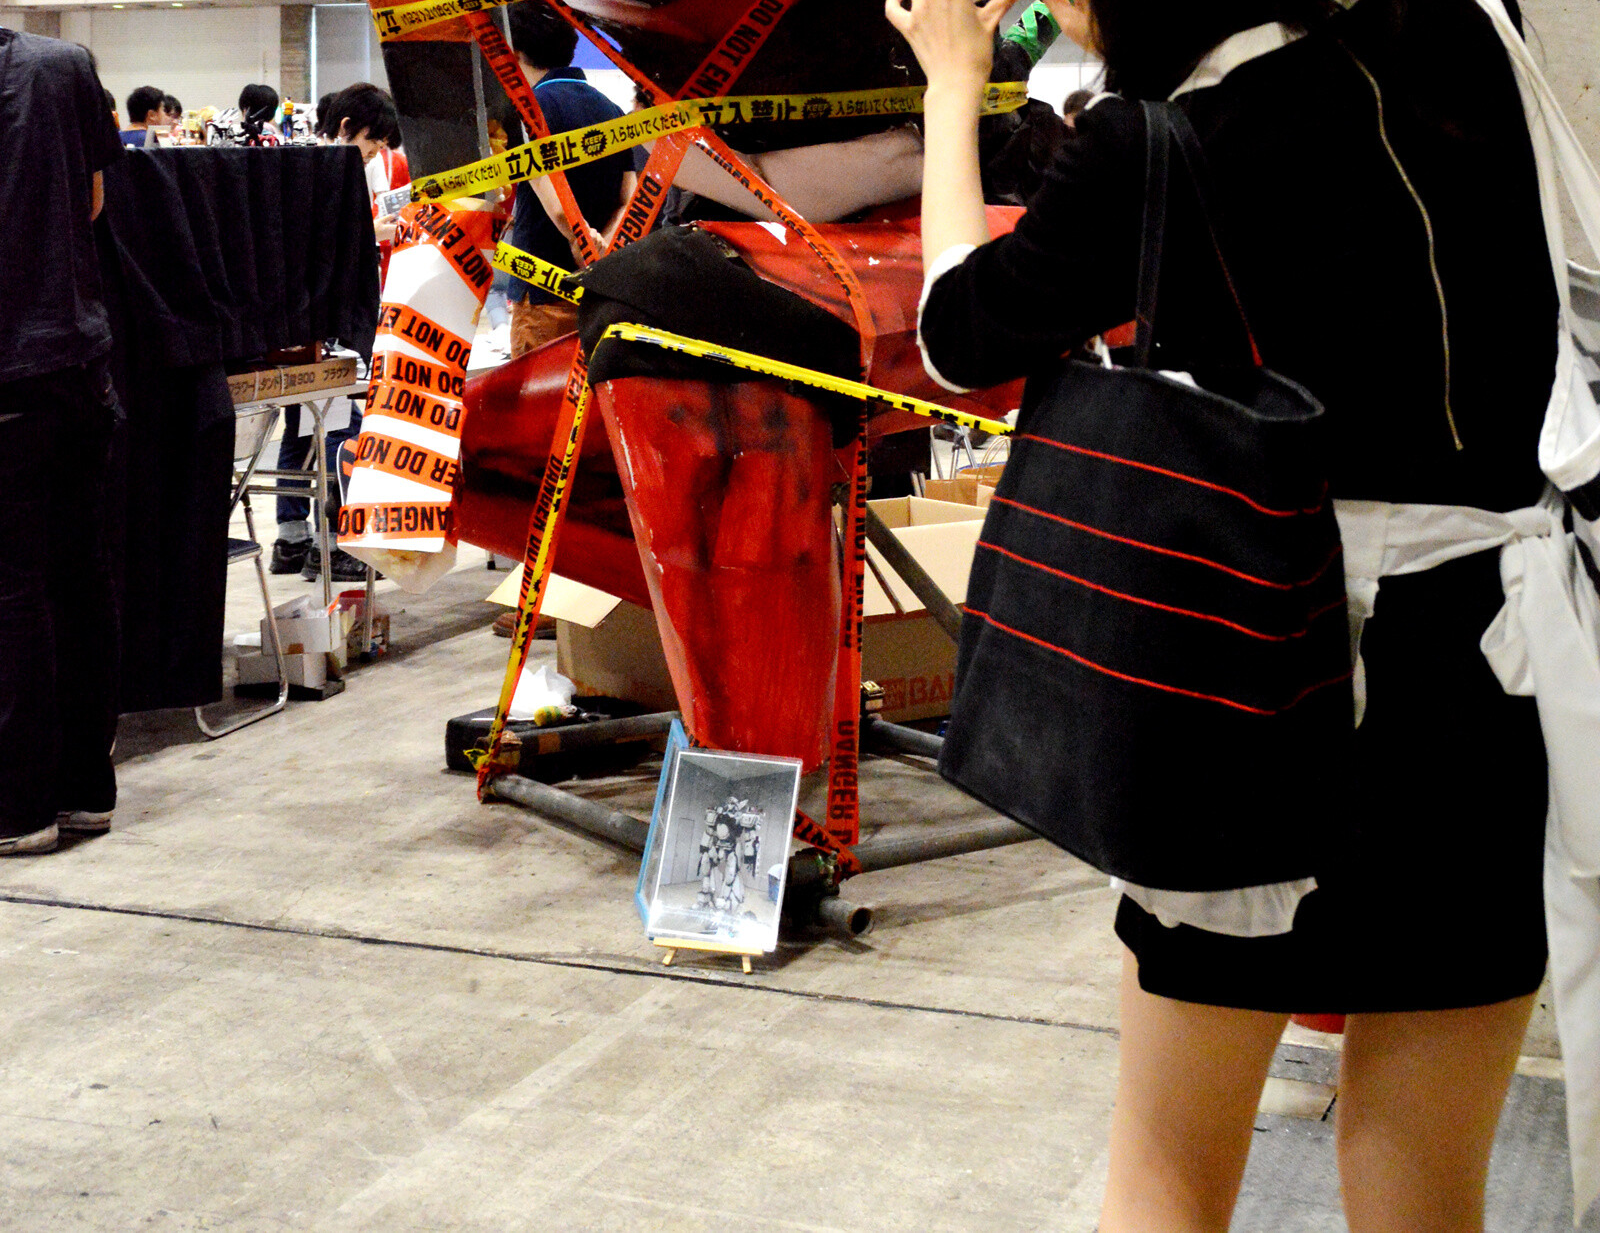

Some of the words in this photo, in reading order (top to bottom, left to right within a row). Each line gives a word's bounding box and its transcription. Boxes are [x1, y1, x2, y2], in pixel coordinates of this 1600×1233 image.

[719, 24, 762, 67] NOT
[681, 62, 731, 100] ENT
[611, 112, 691, 144] 入らないでください
[505, 140, 580, 181] 立入禁止
[588, 144, 601, 155] OUT
[442, 164, 502, 191] 入らないでください
[415, 204, 465, 250] ENTER
[614, 175, 662, 251] DANGE
[454, 245, 492, 289] NOT
[401, 315, 445, 353] NOT
[445, 340, 471, 371] DO
[391, 357, 432, 389] NOT
[438, 371, 464, 398] DO
[380, 386, 426, 419] NOT
[430, 404, 461, 432] DO
[393, 445, 428, 476] DO
[338, 507, 365, 536] DO
